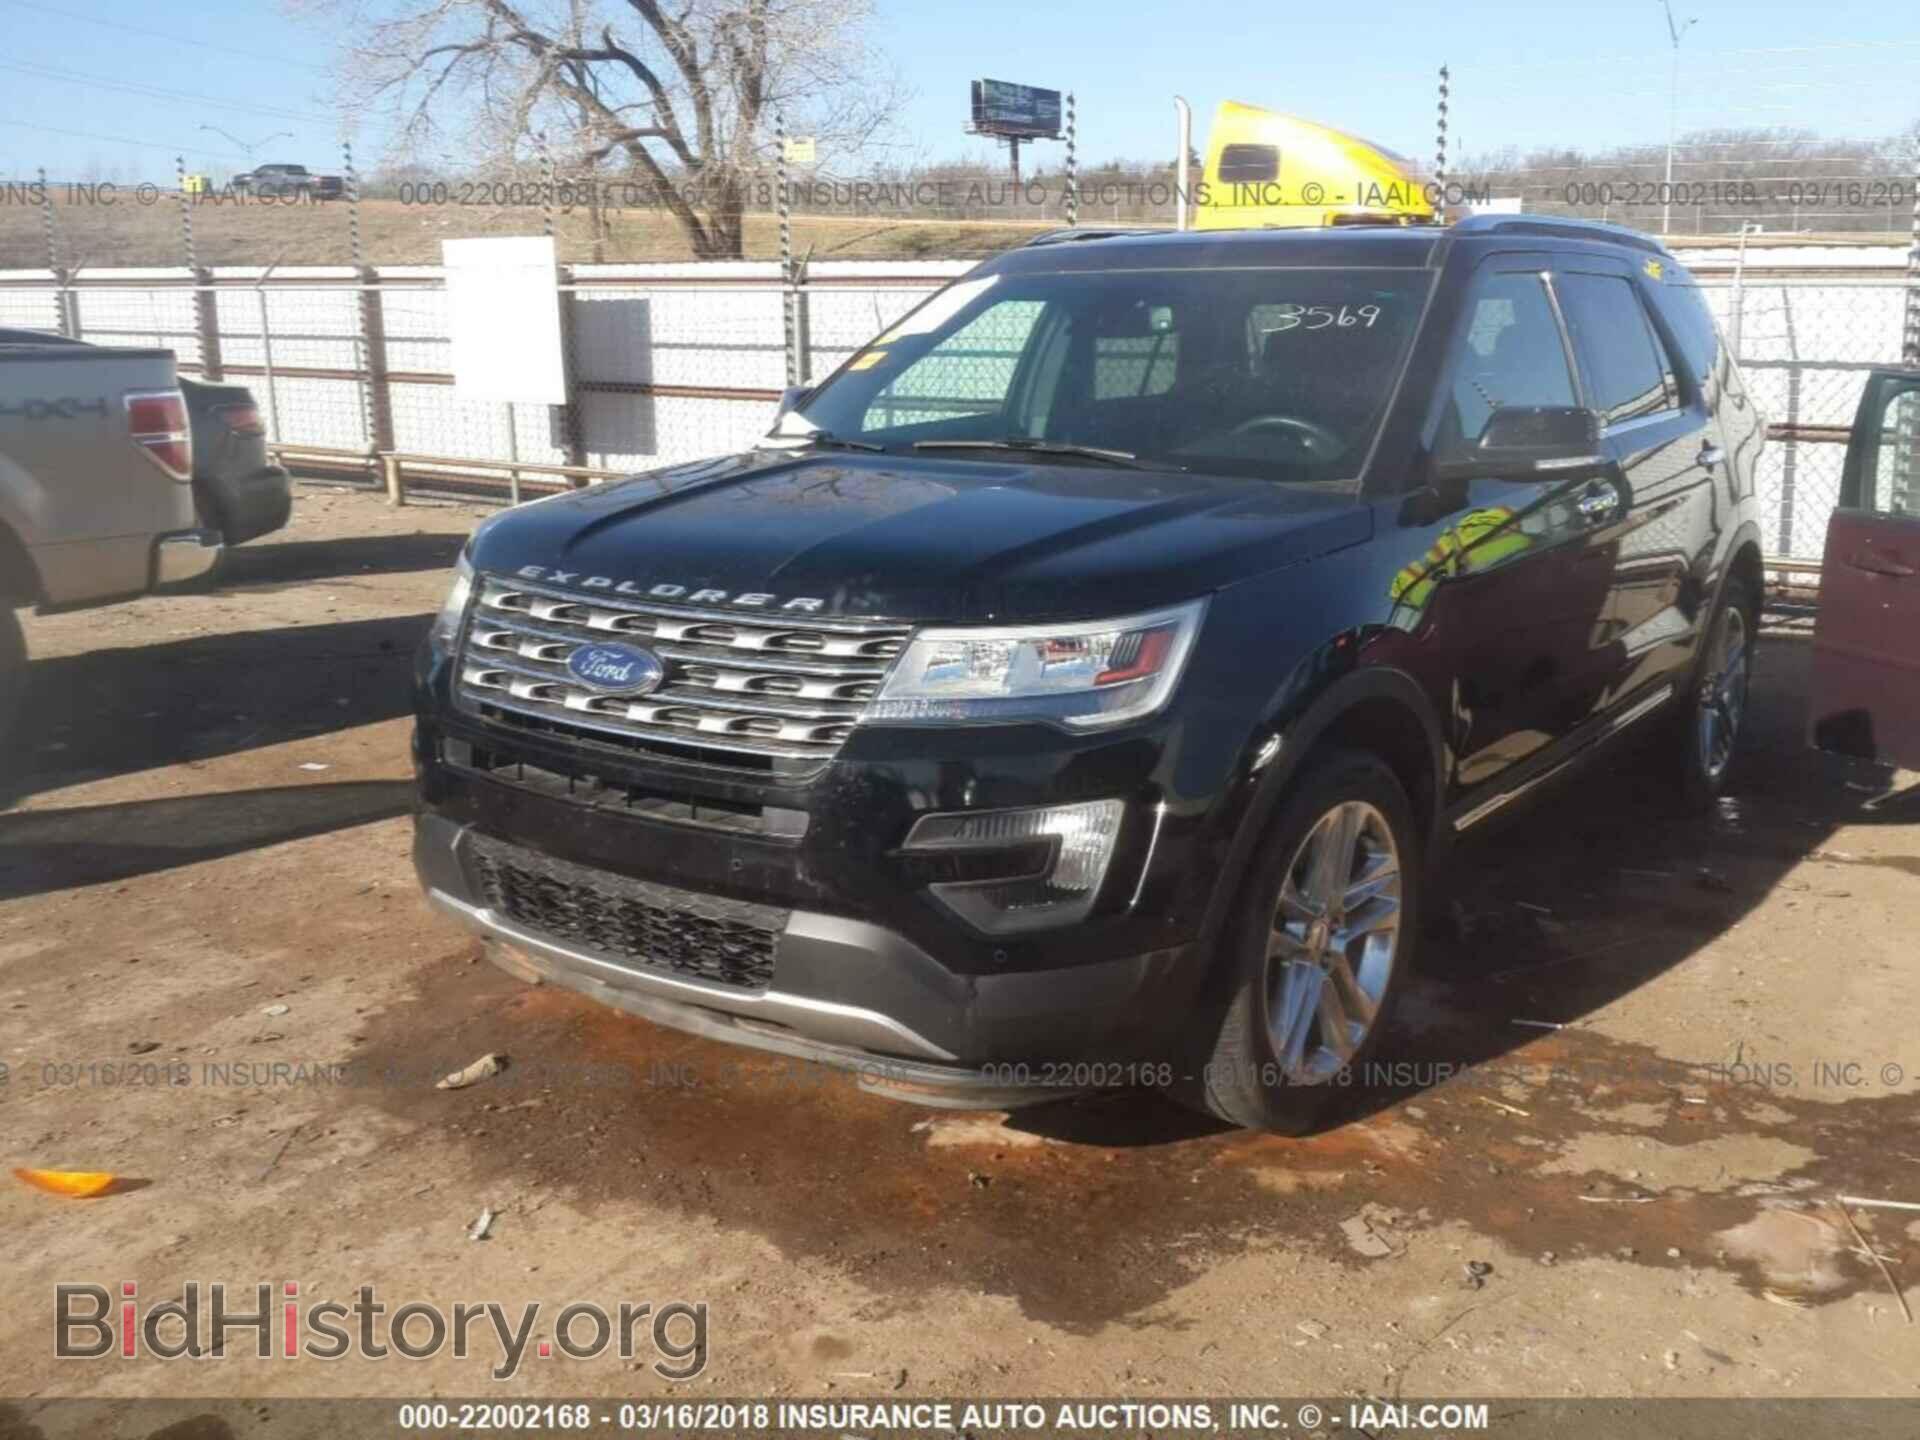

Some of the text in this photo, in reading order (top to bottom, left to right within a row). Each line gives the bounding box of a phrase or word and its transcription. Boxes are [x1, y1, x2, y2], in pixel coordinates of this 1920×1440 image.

[1261, 304, 1380, 332] 3569
[517, 565, 824, 612] EXPLORER
[579, 649, 634, 681] Ford
